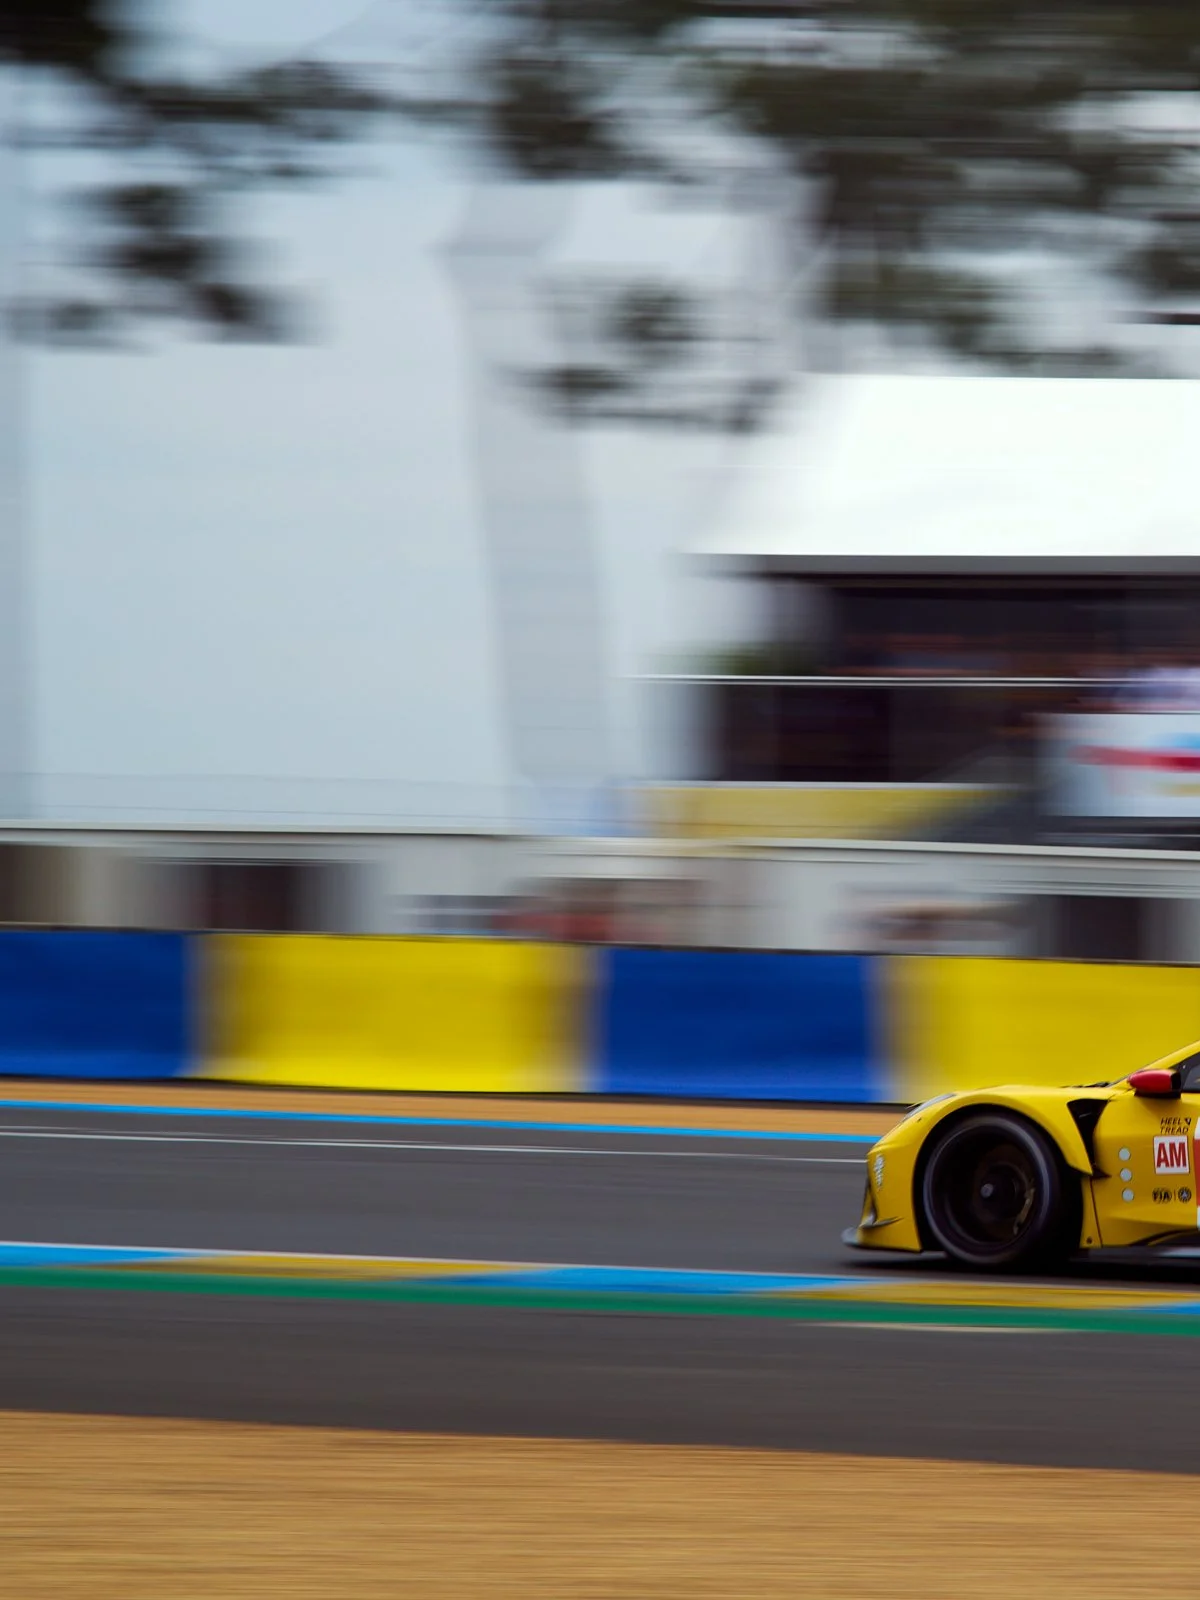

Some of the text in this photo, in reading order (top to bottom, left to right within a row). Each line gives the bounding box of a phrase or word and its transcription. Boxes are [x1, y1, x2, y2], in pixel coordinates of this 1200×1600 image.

[1160, 1117, 1182, 1125] HEEL
[1160, 1126, 1188, 1134] TREAD
[1156, 1142, 1187, 1168] AM
